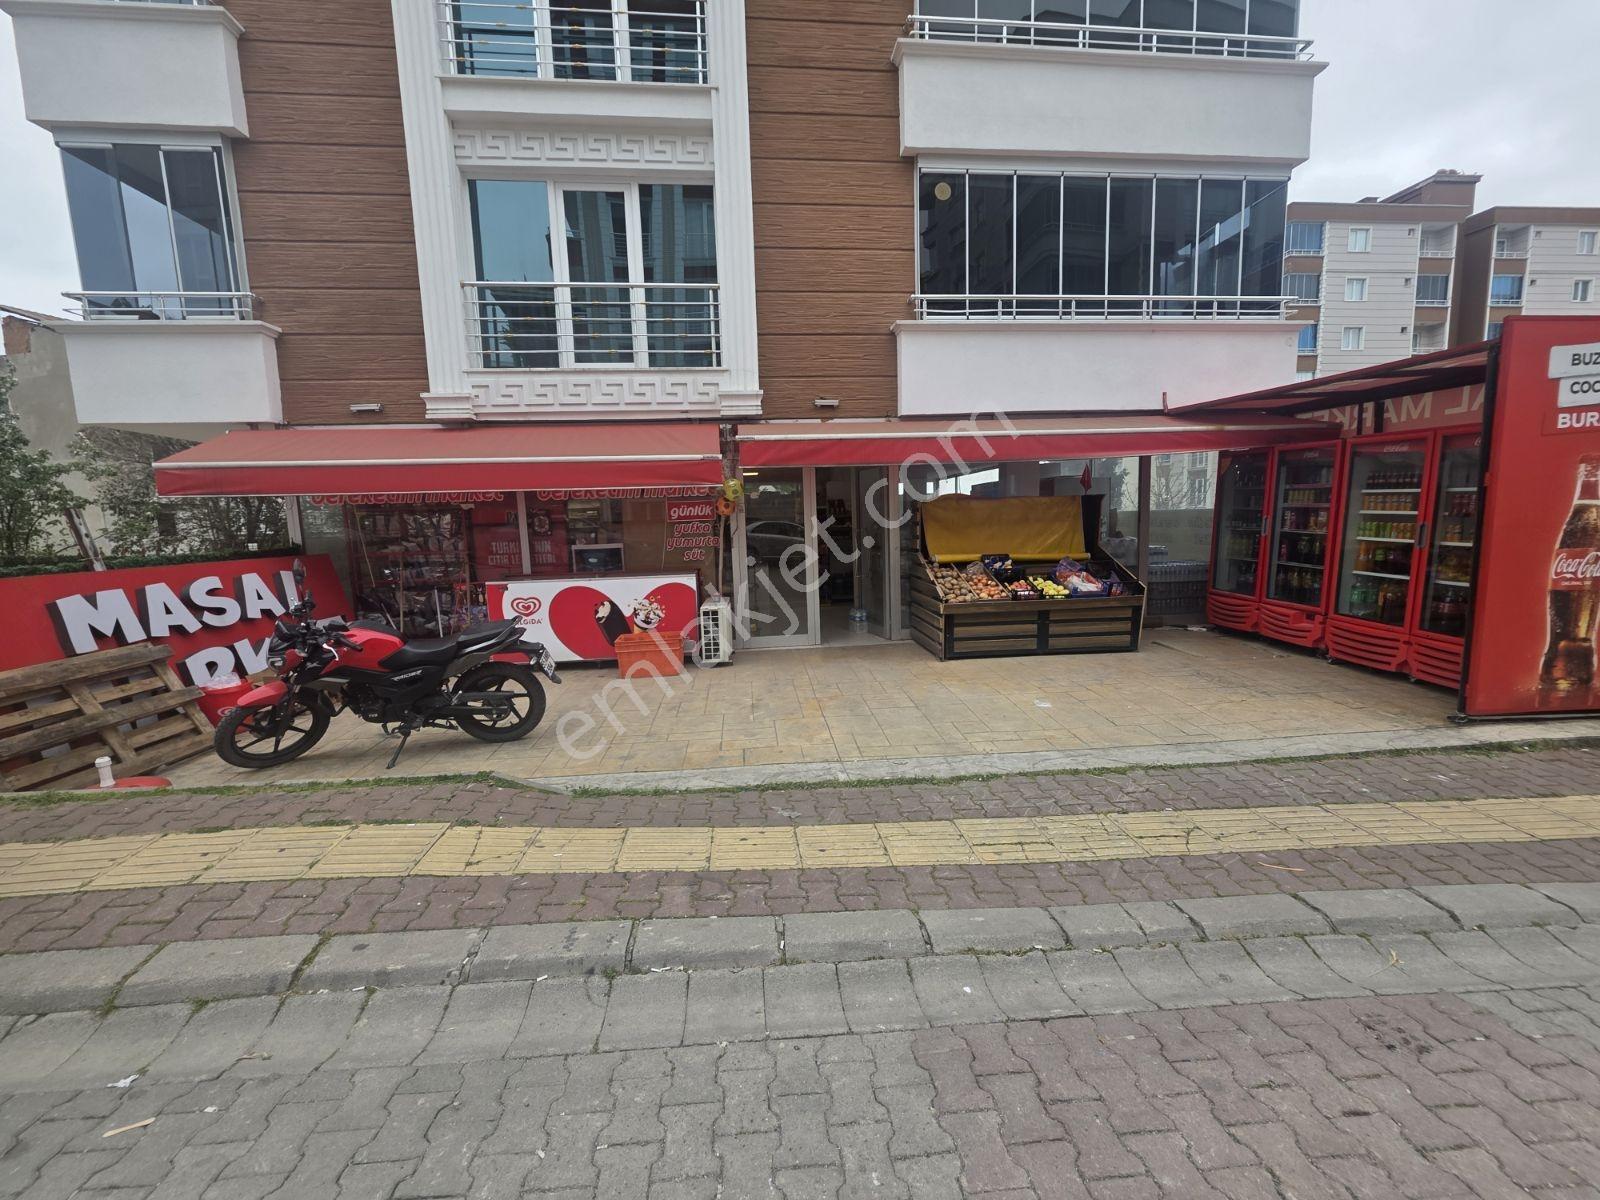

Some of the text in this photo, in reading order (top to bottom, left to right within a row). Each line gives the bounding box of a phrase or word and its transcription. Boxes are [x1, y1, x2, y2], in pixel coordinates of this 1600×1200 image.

[1571, 352, 1600, 366] BUZ
[1557, 411, 1600, 429] BUR
[670, 504, 713, 519] günlük
[674, 522, 711, 537] yufka
[667, 536, 720, 551] yumurta
[684, 548, 706, 561] süt
